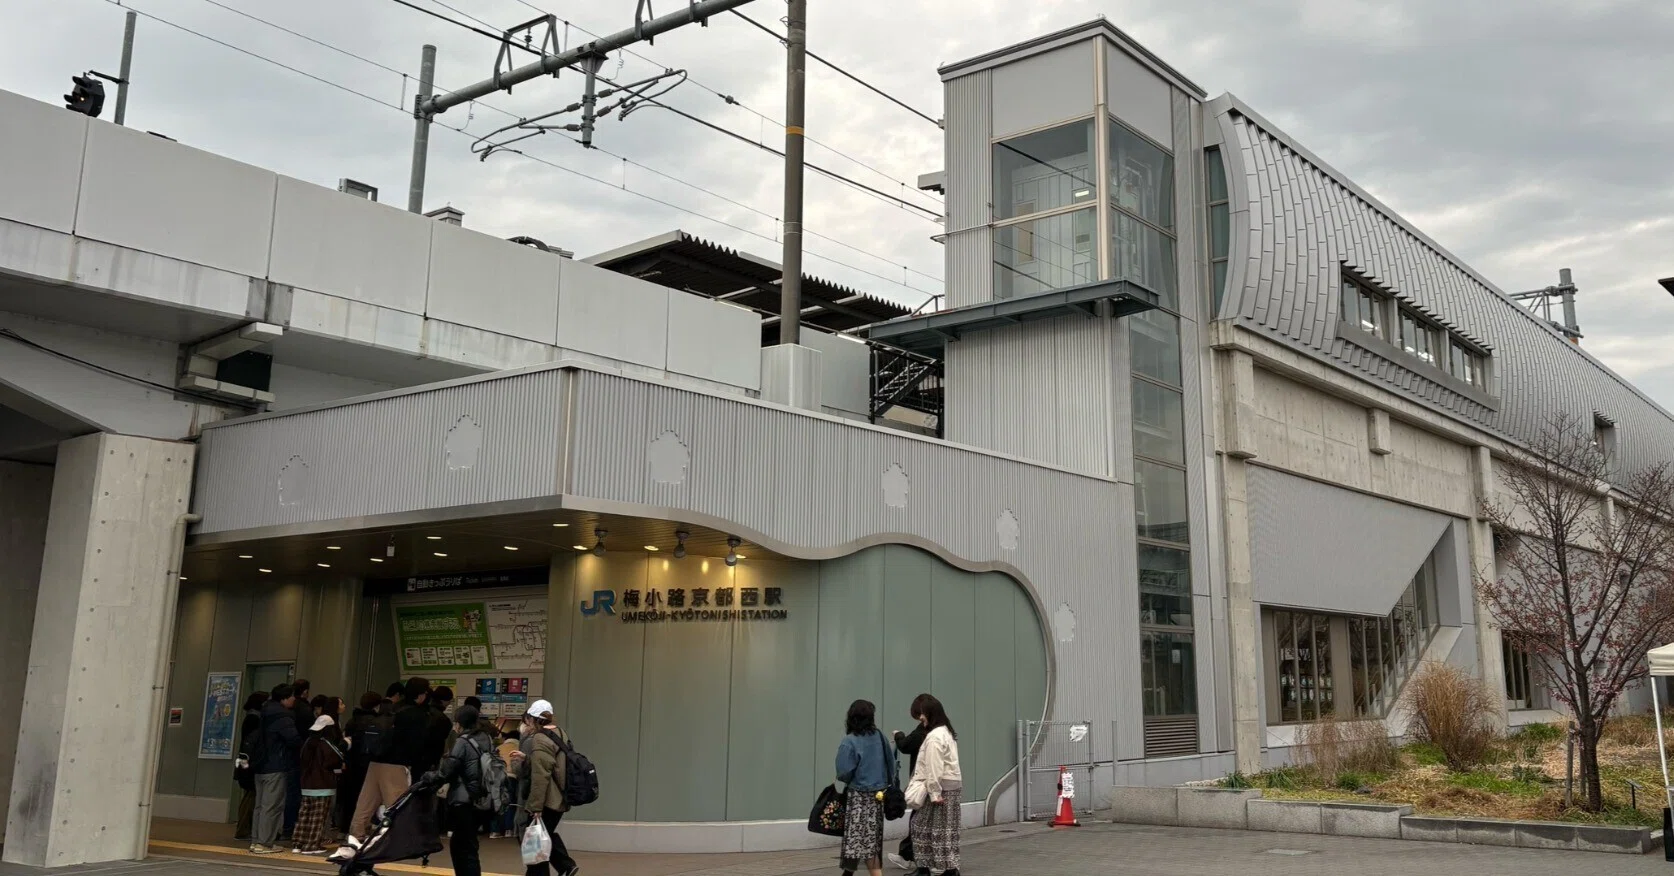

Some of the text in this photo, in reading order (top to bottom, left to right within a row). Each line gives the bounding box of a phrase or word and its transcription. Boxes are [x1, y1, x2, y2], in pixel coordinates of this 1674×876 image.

[581, 590, 616, 615] JR
[623, 587, 782, 607] 梅小路京都西駅
